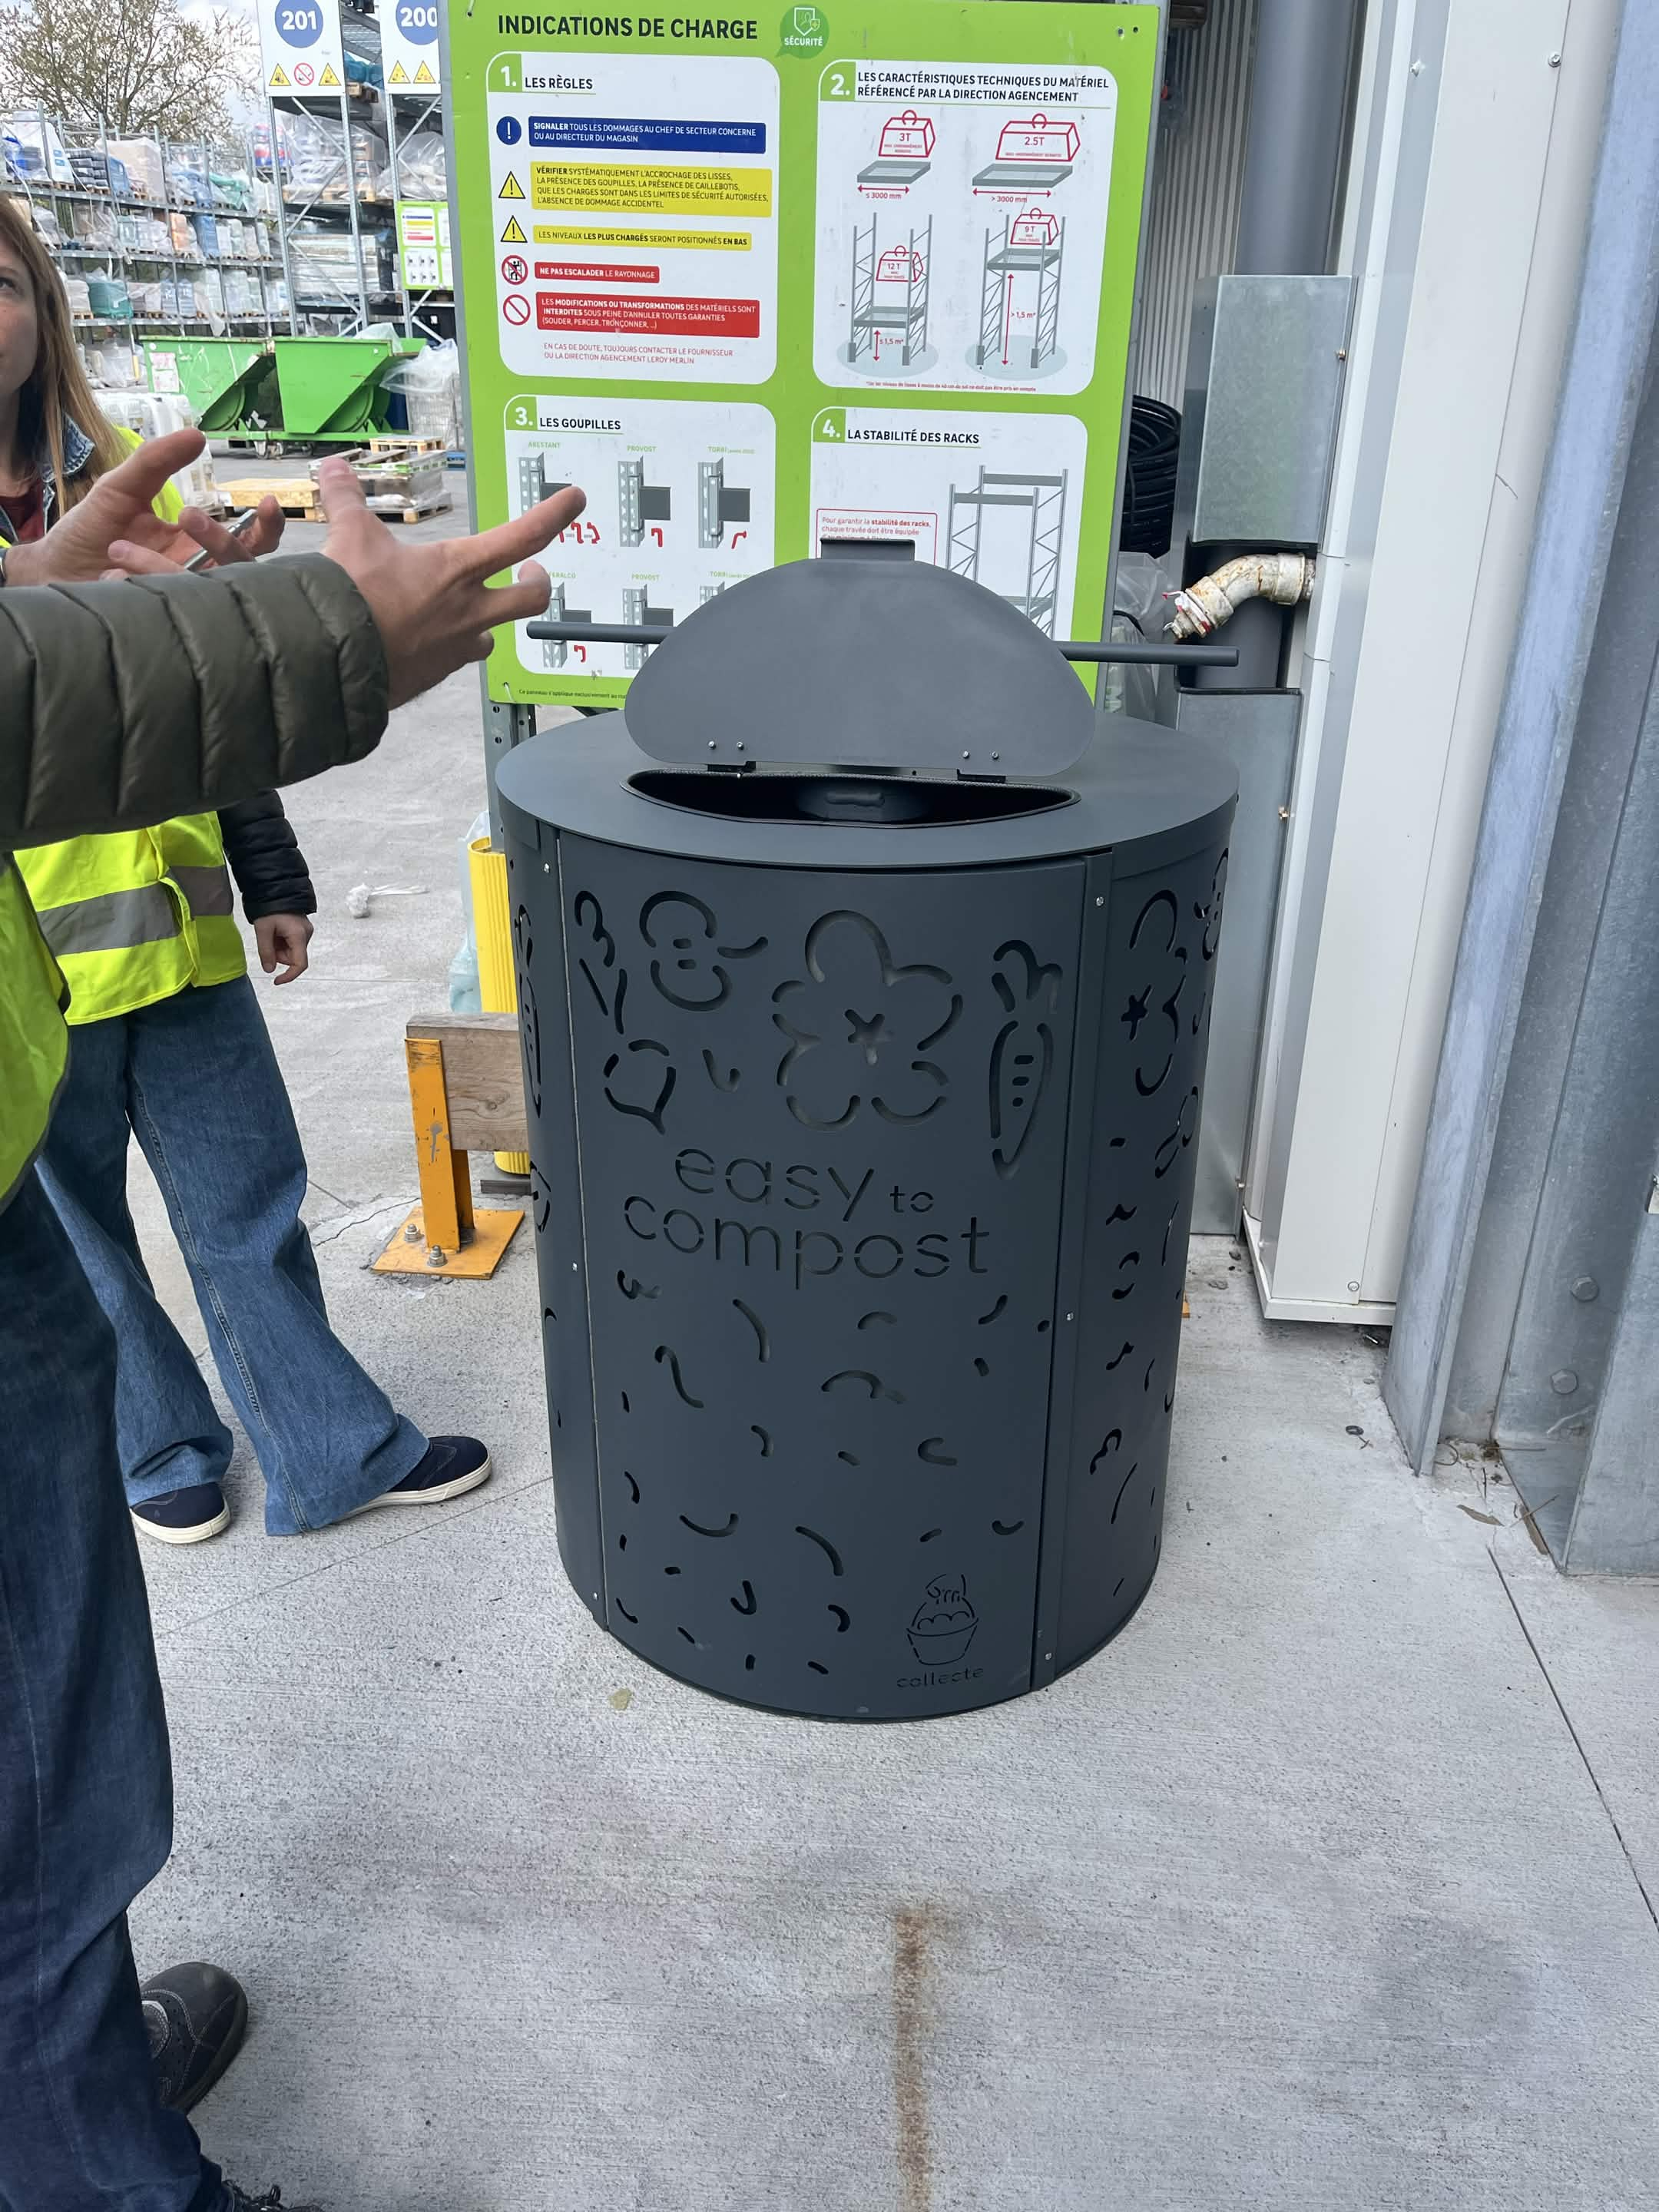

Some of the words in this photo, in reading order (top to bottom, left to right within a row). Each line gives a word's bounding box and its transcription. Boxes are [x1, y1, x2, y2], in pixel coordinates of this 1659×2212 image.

[282, 10, 317, 31] 201
[400, 7, 437, 28] 200
[498, 15, 633, 37] INDICATIONS
[637, 18, 665, 38] DE
[671, 19, 758, 40] CHARGE
[784, 36, 823, 47] SÉCURITÉ
[501, 66, 517, 87] 1.
[525, 77, 546, 88] LES
[548, 75, 593, 90] RÈGLES
[858, 72, 876, 82] LES
[878, 71, 975, 85] CARACTÉRISTIQUES
[976, 75, 1041, 87] TECHNIQUES
[1043, 77, 1057, 87] DU
[1059, 75, 1109, 88] MATÉRIEL
[830, 74, 850, 96] 2.
[858, 84, 915, 98] RÉFÉRENCÉ
[918, 88, 935, 98] PAR
[939, 88, 952, 98] LA
[953, 89, 1006, 100] DIRECTION
[1008, 91, 1079, 102] AGENCEMENT
[534, 122, 568, 131] SIGNALER
[570, 123, 588, 131] TOUS
[603, 124, 644, 133] DOMMAGES
[675, 126, 685, 134] DE
[686, 127, 717, 135] SECTEUR
[555, 133, 594, 141] DIRECTEUR
[595, 134, 605, 142] DU
[606, 134, 638, 143] MAGASIN
[899, 132, 912, 142] 3T
[1025, 136, 1045, 146] 2.5T
[536, 165, 568, 174] VÉRIFIER
[568, 167, 638, 177] SYSTÉMATIQUEMENT
[693, 171, 707, 180] DES
[707, 172, 733, 181] LISSES,
[546, 177, 581, 185] PRÉSENCE
[648, 180, 683, 189] PRÉSENCE
[537, 187, 551, 195] QUE
[566, 187, 598, 196] CHARGES
[653, 190, 680, 199] LIMITES
[692, 190, 724, 200] SÉCURITÉ
[585, 198, 621, 207] DOMMAGE
[621, 199, 664, 209] ACCIDENTEL
[615, 233, 648, 242] CHARGÉS
[677, 236, 722, 245] POSITIONNÉS
[565, 268, 604, 276] ESCALADER
[614, 270, 655, 279] RAYONNAGE
[555, 299, 608, 307] MODIFICATIONS
[620, 300, 685, 310] TRANSFORMATIONS
[700, 303, 737, 312] MATÉRIELS
[661, 312, 687, 320] TOUTES
[600, 353, 645, 363] AGENCEMENT
[638, 346, 677, 354] CONTACTER
[687, 348, 733, 356] FOURNISSEUR
[515, 406, 533, 426] 3.
[540, 417, 559, 428] LES
[561, 418, 621, 430] GOUPILLES
[823, 419, 841, 438] 4.
[847, 429, 861, 439] LA
[863, 429, 917, 442] STABILITÉ
[920, 432, 942, 442] DES
[944, 432, 979, 444] RACKS
[675, 1148, 874, 1222] easy
[889, 1185, 934, 1213] to
[624, 1195, 990, 1290] compost
[896, 1667, 984, 1688] collecte
